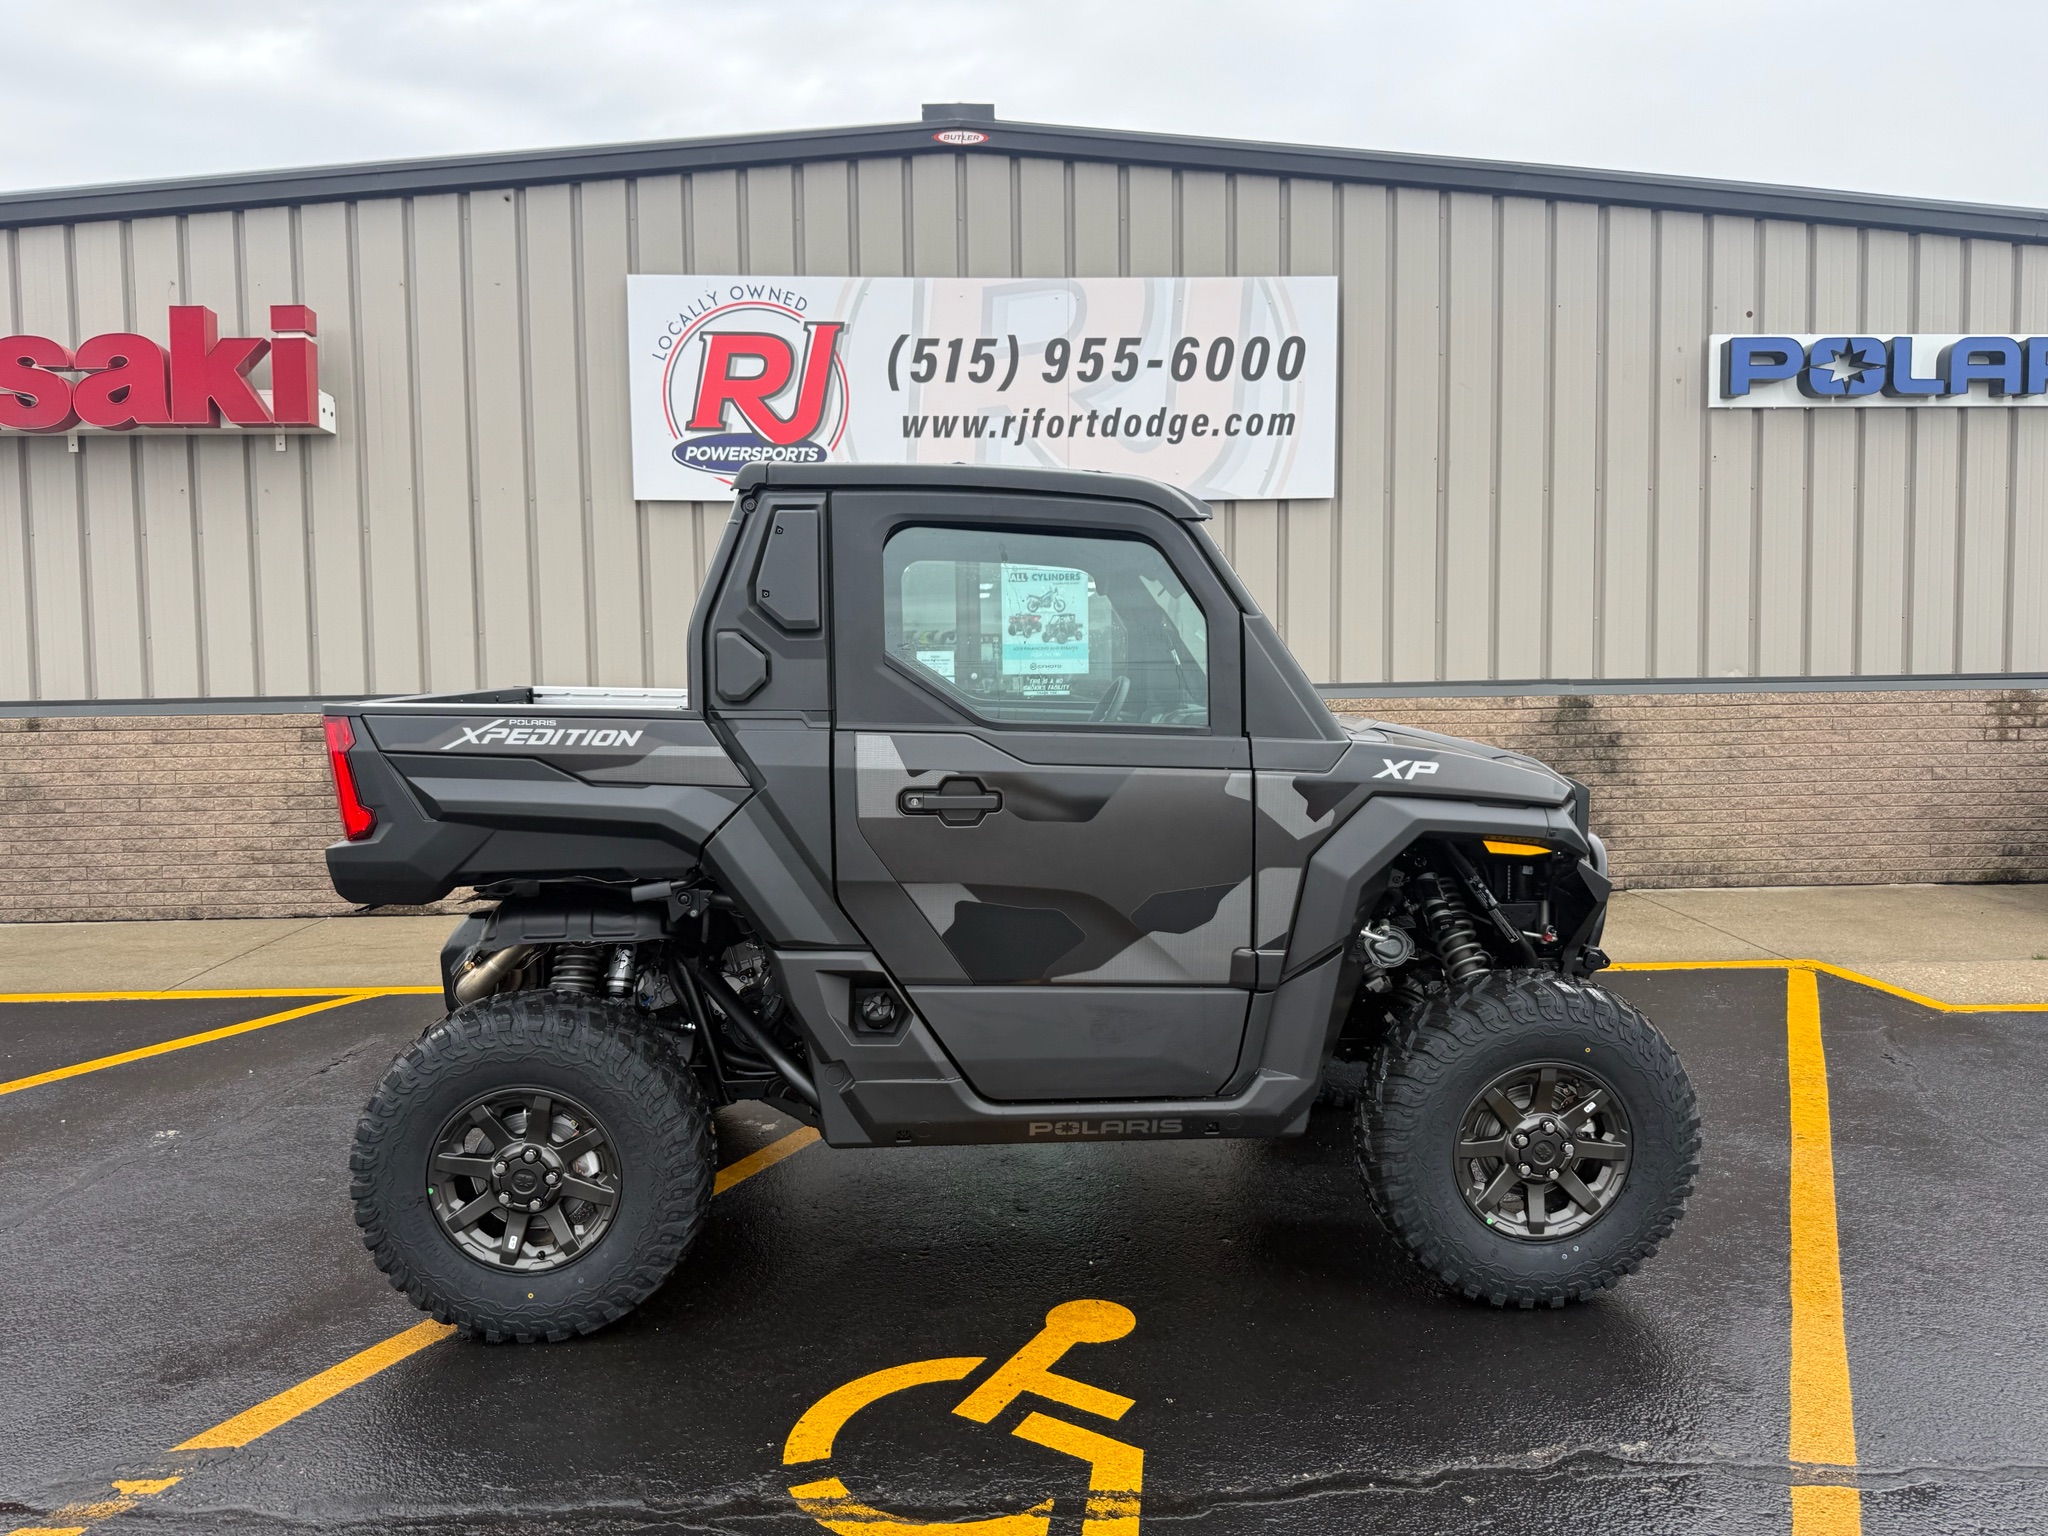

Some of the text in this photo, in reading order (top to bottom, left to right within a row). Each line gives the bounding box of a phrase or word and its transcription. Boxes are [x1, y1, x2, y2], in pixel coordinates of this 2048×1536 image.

[652, 284, 808, 361] LOCALLY OWNED
[887, 333, 1307, 392] (515) 955-6000
[685, 321, 846, 446] RJ
[902, 406, 1297, 446] www.rjfortdodge.com
[684, 446, 819, 462] POWERSPORTS
[1031, 573, 1081, 582] CYLINDERS
[439, 718, 644, 750] XPEDITION
[508, 719, 557, 727] POLARIS
[1371, 758, 1440, 780] XP
[1029, 1118, 1184, 1137] POLARIS
